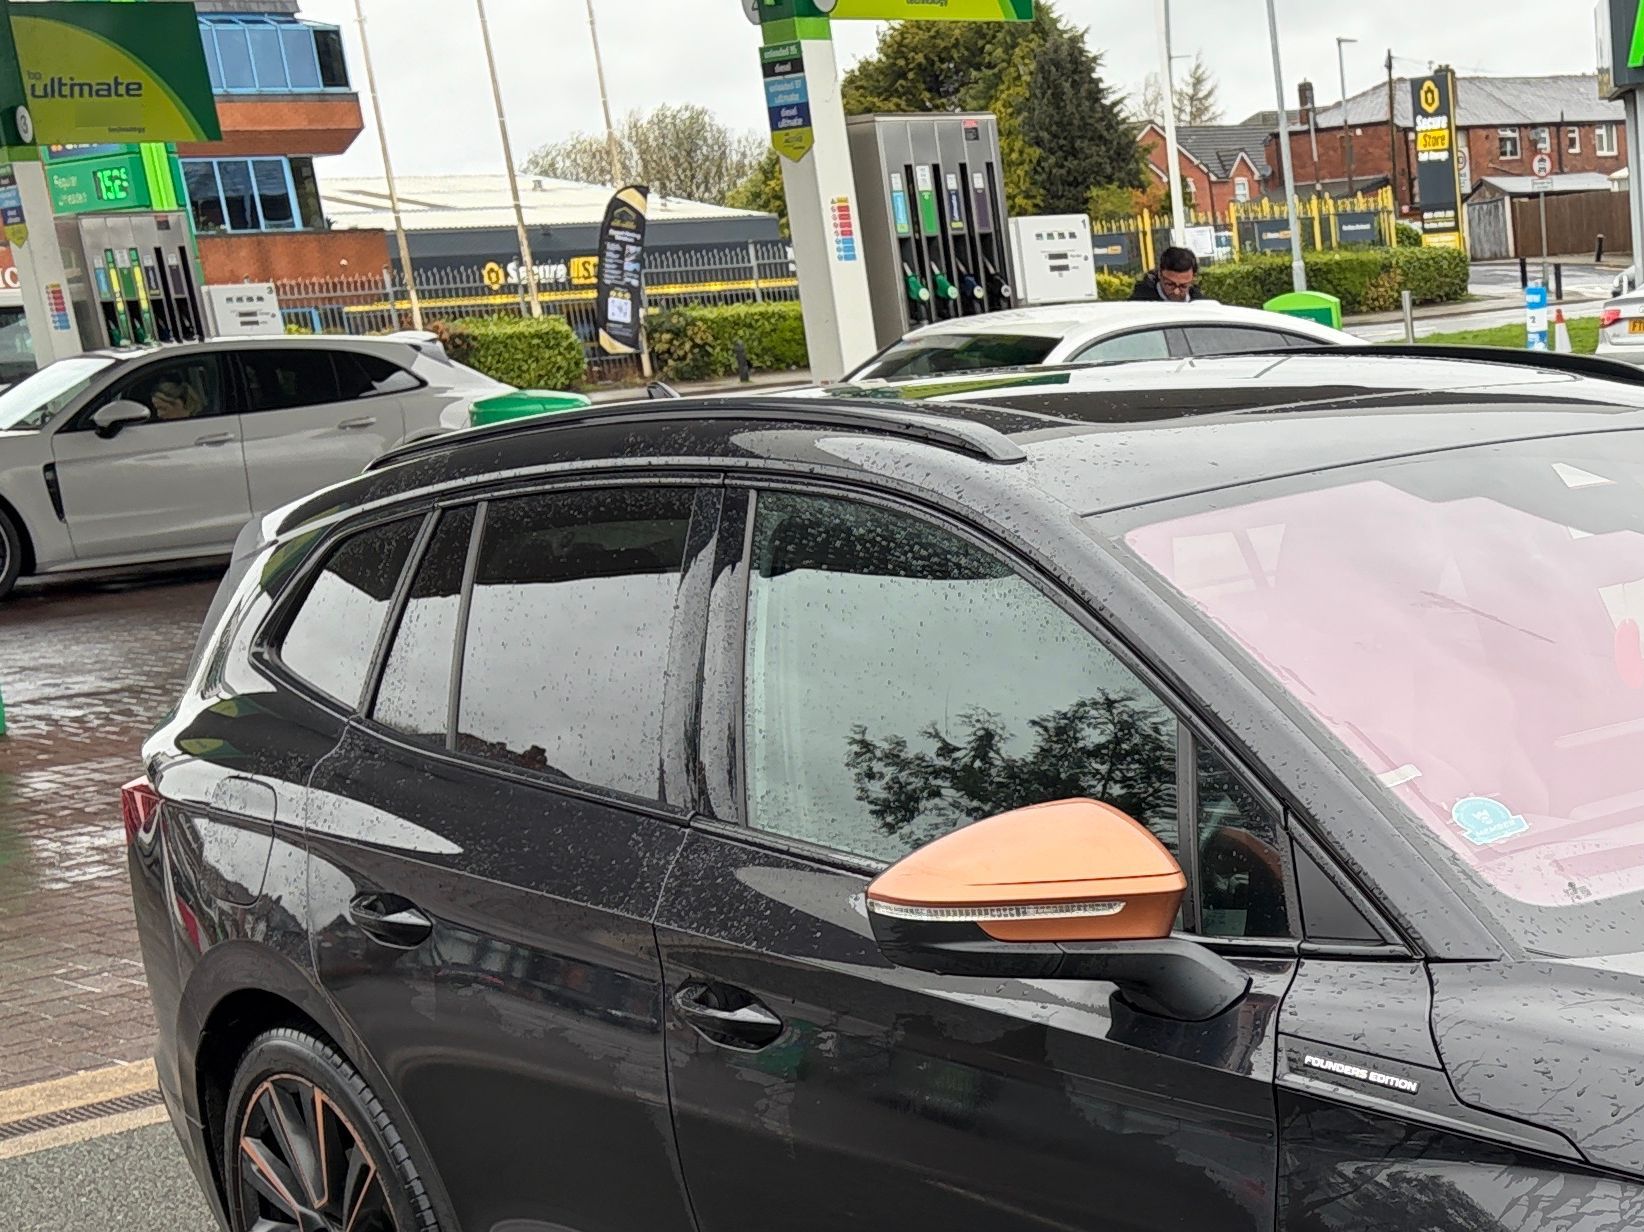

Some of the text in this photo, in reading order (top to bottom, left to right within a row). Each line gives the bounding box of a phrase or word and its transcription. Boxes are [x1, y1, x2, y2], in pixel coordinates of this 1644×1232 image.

[30, 76, 143, 99] ultimate
[1415, 114, 1448, 132] Secure
[1422, 133, 1446, 149] Store
[1304, 1055, 1418, 1093] FOUNDERS EDITION
